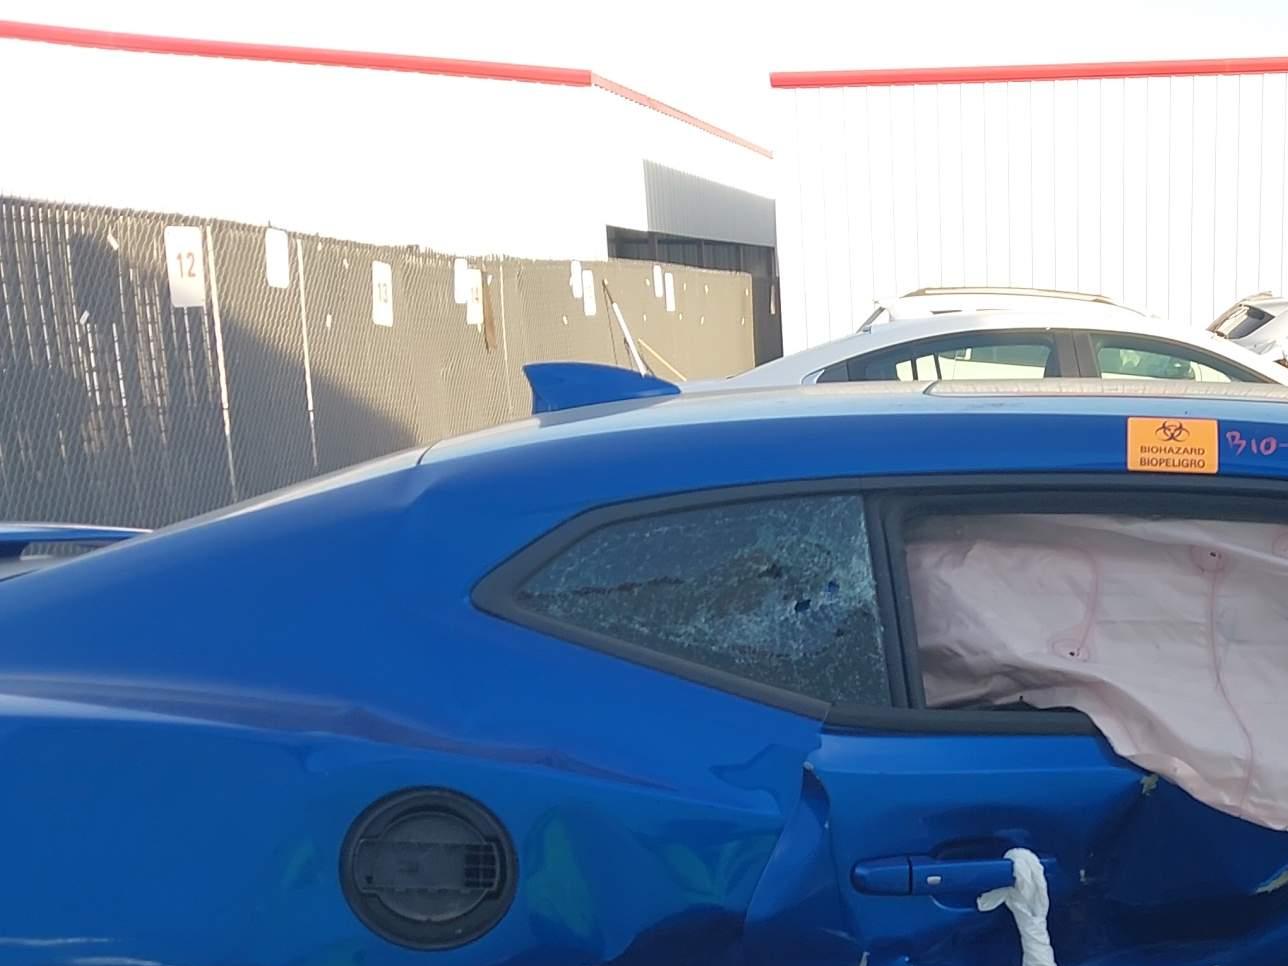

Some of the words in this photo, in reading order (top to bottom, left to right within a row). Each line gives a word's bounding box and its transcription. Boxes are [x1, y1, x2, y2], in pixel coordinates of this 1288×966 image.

[176, 251, 197, 279] 12
[1139, 445, 1206, 457] BIOHAZARD
[1139, 457, 1206, 469] BIOPELIGRO
